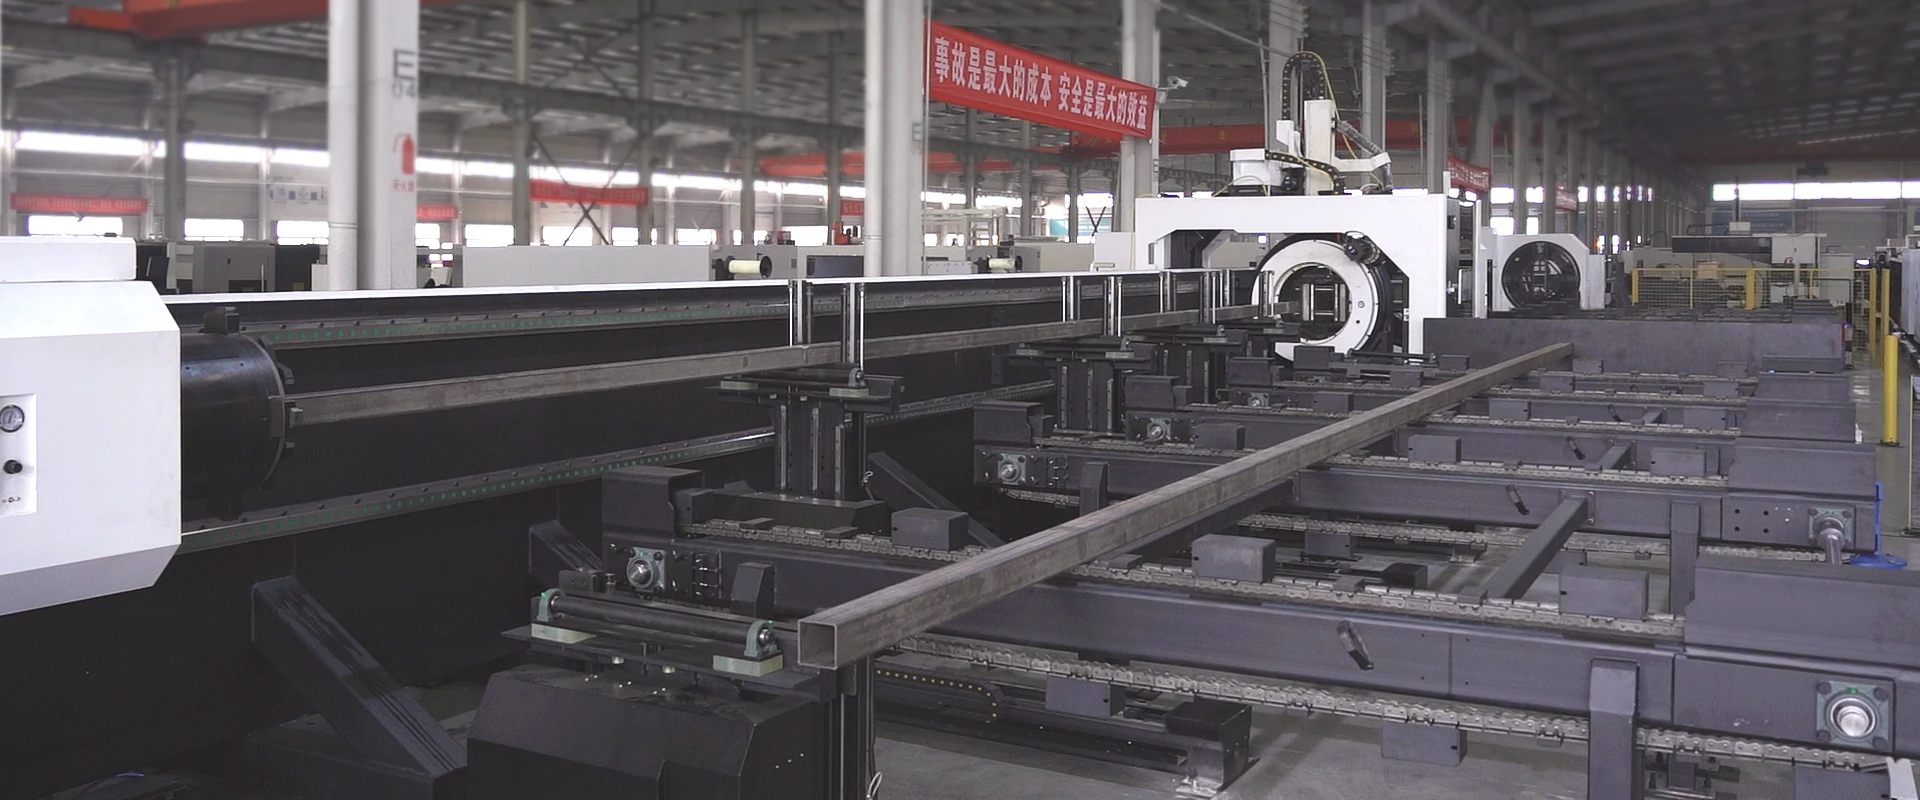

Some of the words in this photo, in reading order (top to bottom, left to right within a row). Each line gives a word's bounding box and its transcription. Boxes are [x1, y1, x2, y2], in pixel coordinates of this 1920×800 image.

[393, 48, 417, 80] E
[934, 37, 1052, 107] 事故是最大的成本
[1058, 72, 1148, 130] 安全是最大的效益
